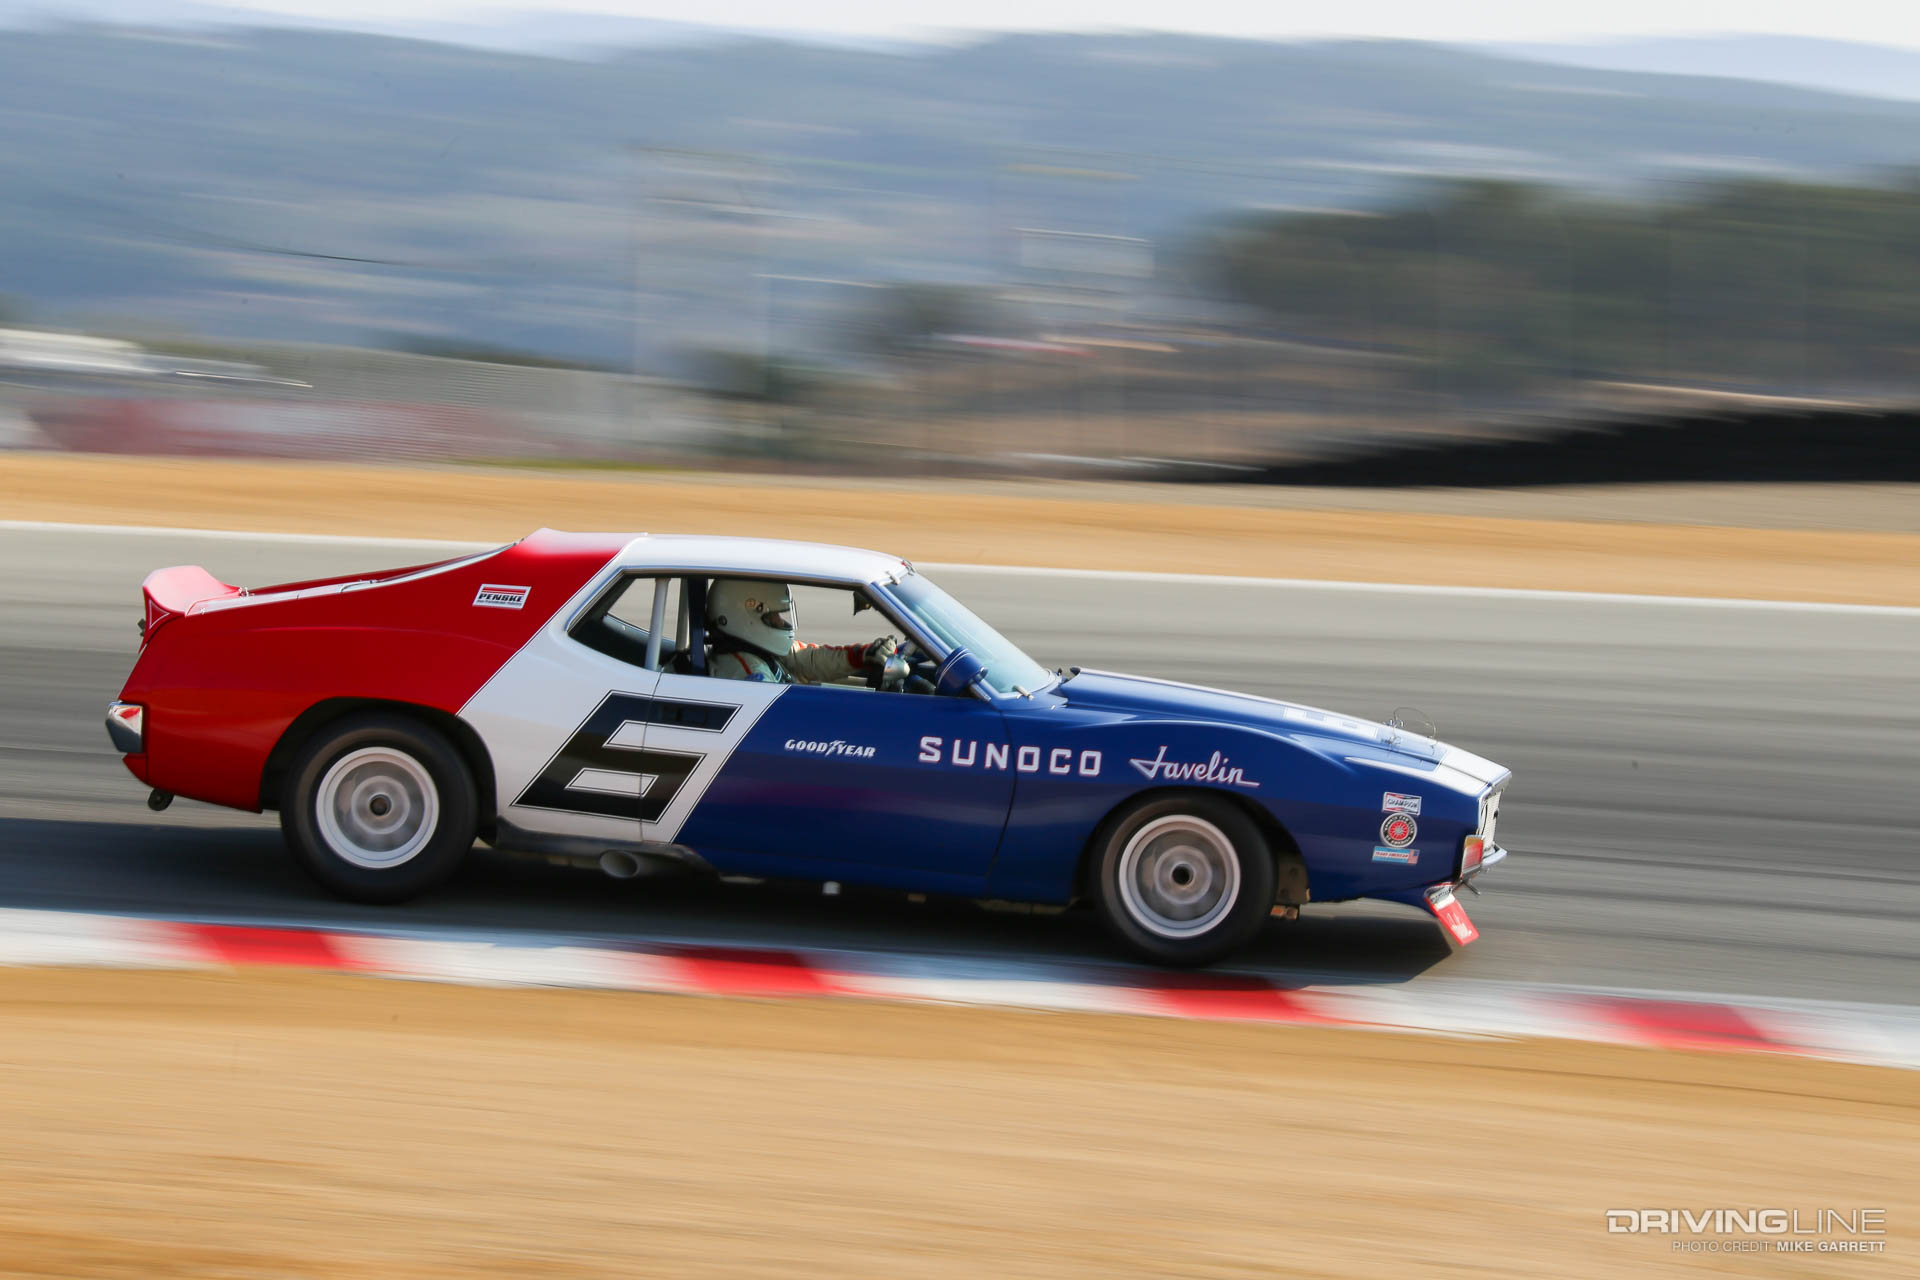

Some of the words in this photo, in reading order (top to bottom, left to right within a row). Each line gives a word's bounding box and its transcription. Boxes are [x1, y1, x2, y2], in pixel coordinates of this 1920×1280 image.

[478, 593, 523, 602] PENSKE
[508, 689, 744, 825] 6
[784, 738, 877, 758] GOODYEAR
[918, 736, 1102, 777] SUNOCO
[1128, 745, 1261, 788] Javelin
[1387, 798, 1418, 809] CHAMPION
